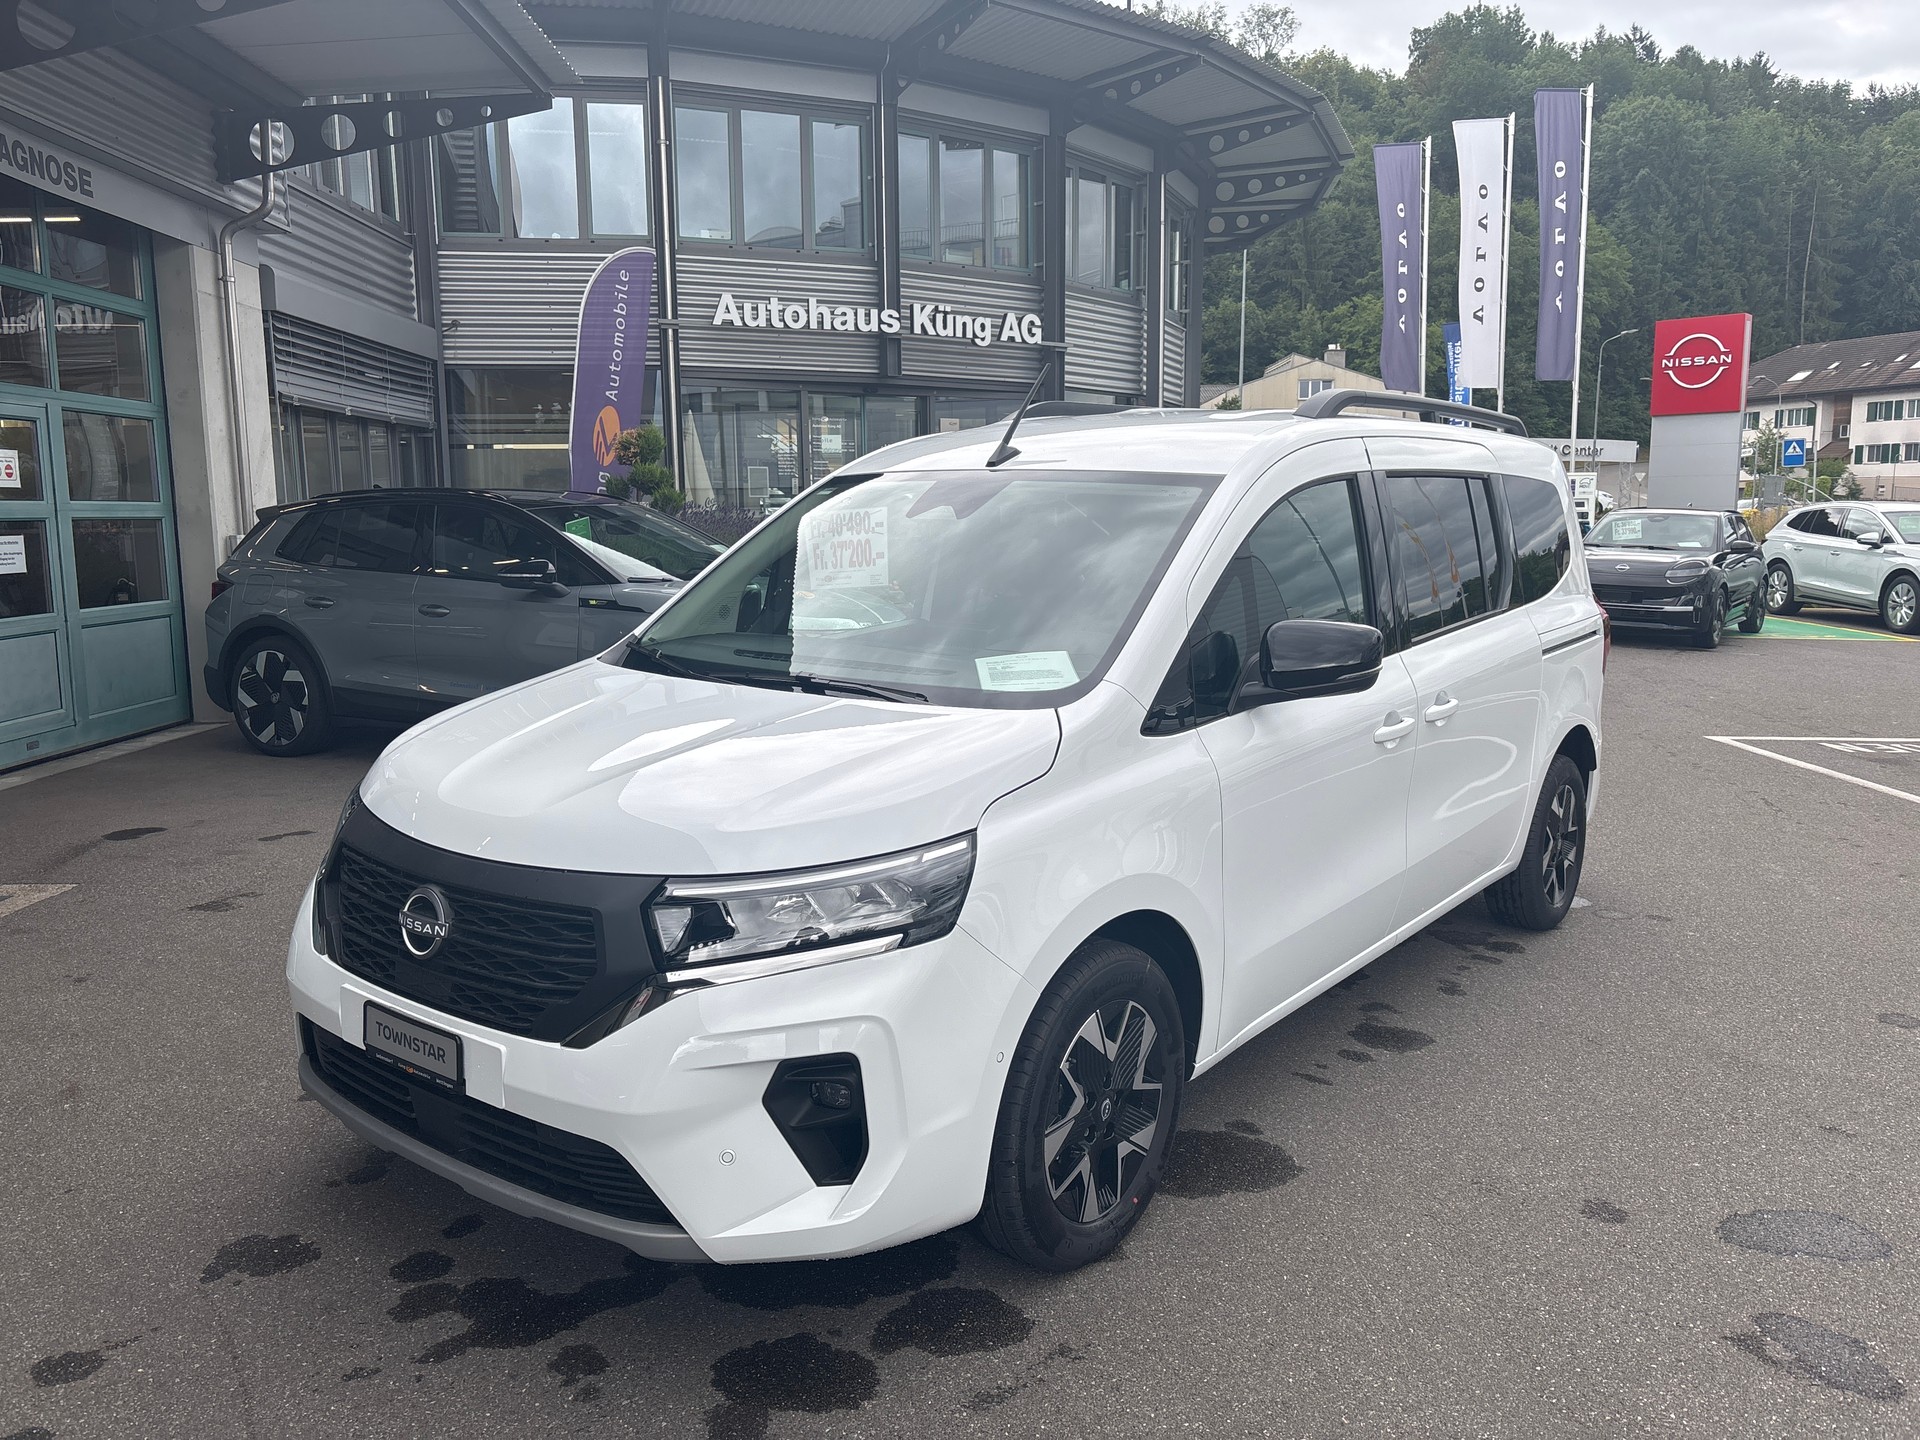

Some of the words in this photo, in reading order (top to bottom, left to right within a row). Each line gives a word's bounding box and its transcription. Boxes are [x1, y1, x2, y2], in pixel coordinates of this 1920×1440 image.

[0, 132, 94, 199] AGNOSE
[605, 269, 630, 402] Automobile
[711, 292, 900, 333] Autohaus
[911, 303, 992, 347] Küng
[1000, 312, 1043, 344] AG
[1661, 354, 1732, 368] NISSAN
[1562, 444, 1604, 456] Center
[812, 543, 828, 570] Fr.
[399, 912, 446, 937] NISSAN
[375, 1021, 447, 1064] TOWNSTAR
